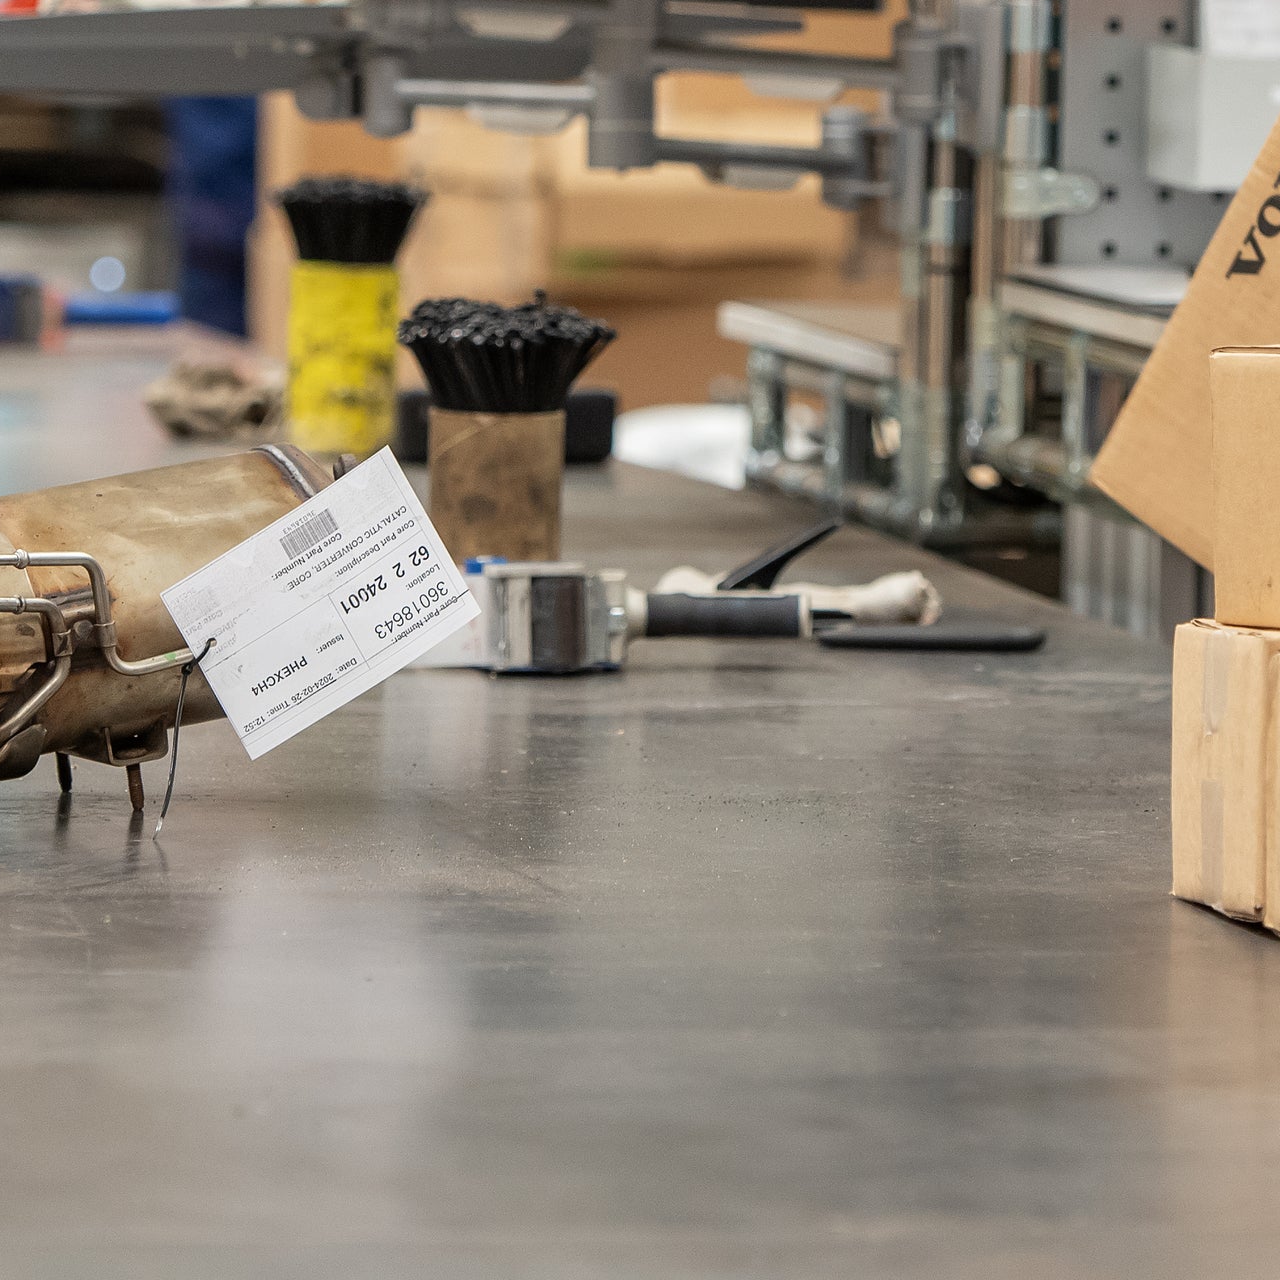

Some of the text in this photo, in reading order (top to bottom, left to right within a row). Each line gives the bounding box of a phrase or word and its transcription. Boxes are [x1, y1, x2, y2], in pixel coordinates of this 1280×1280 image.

[271, 532, 341, 580] Core Part Number:
[285, 505, 406, 591] CATALYTIC CONVERTER, CORE
[334, 519, 414, 577] Core Part Description:
[405, 563, 440, 590] Location:
[339, 545, 429, 614] 62 2 24001
[374, 581, 448, 639] 36018643
[390, 595, 457, 644] Core Part Number:
[251, 633, 344, 696] Issuer: PHEXCH4
[242, 657, 357, 732] Date: 2024-02-26 Time: 12:52
